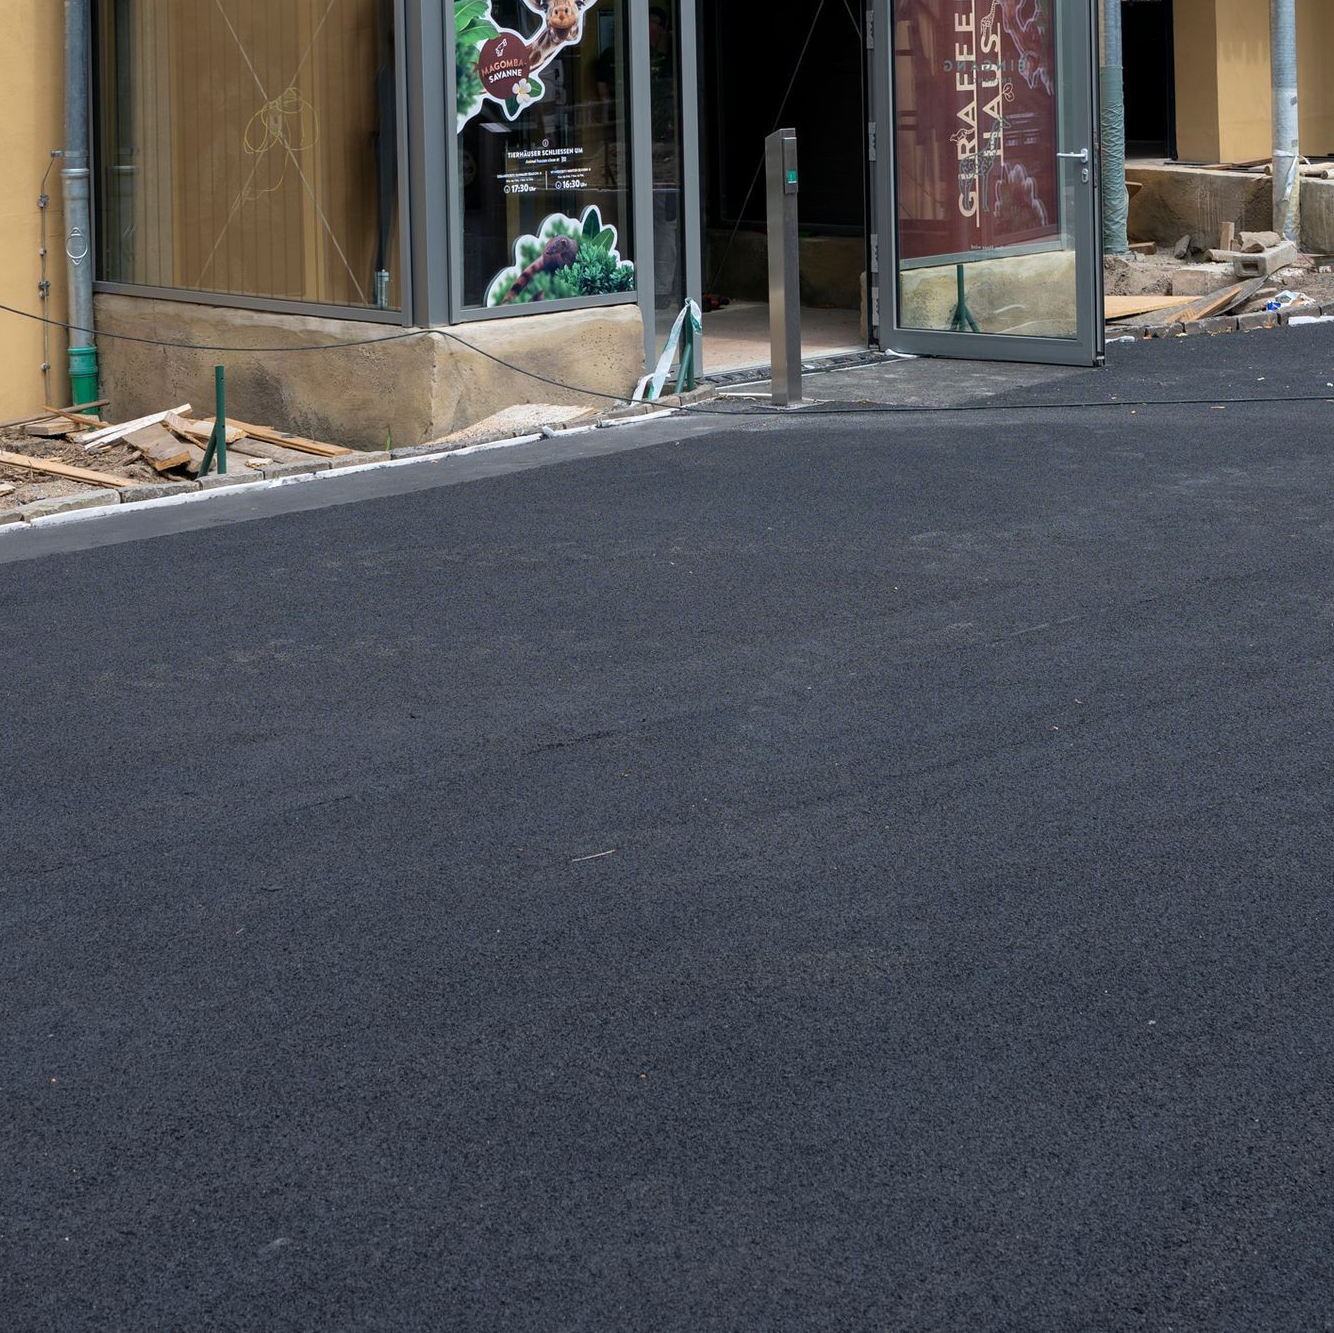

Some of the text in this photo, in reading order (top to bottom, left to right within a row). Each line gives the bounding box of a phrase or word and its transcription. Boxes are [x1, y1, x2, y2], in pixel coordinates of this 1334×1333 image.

[481, 59, 527, 76] MAGOMBA-
[488, 69, 522, 84] SAVANNE
[981, 33, 1001, 156] HAUS
[507, 150, 541, 158] TIERHÄUSER
[542, 148, 573, 156] SCHLIESSEN
[511, 184, 529, 193] 17:30
[562, 180, 580, 189] 16:30
